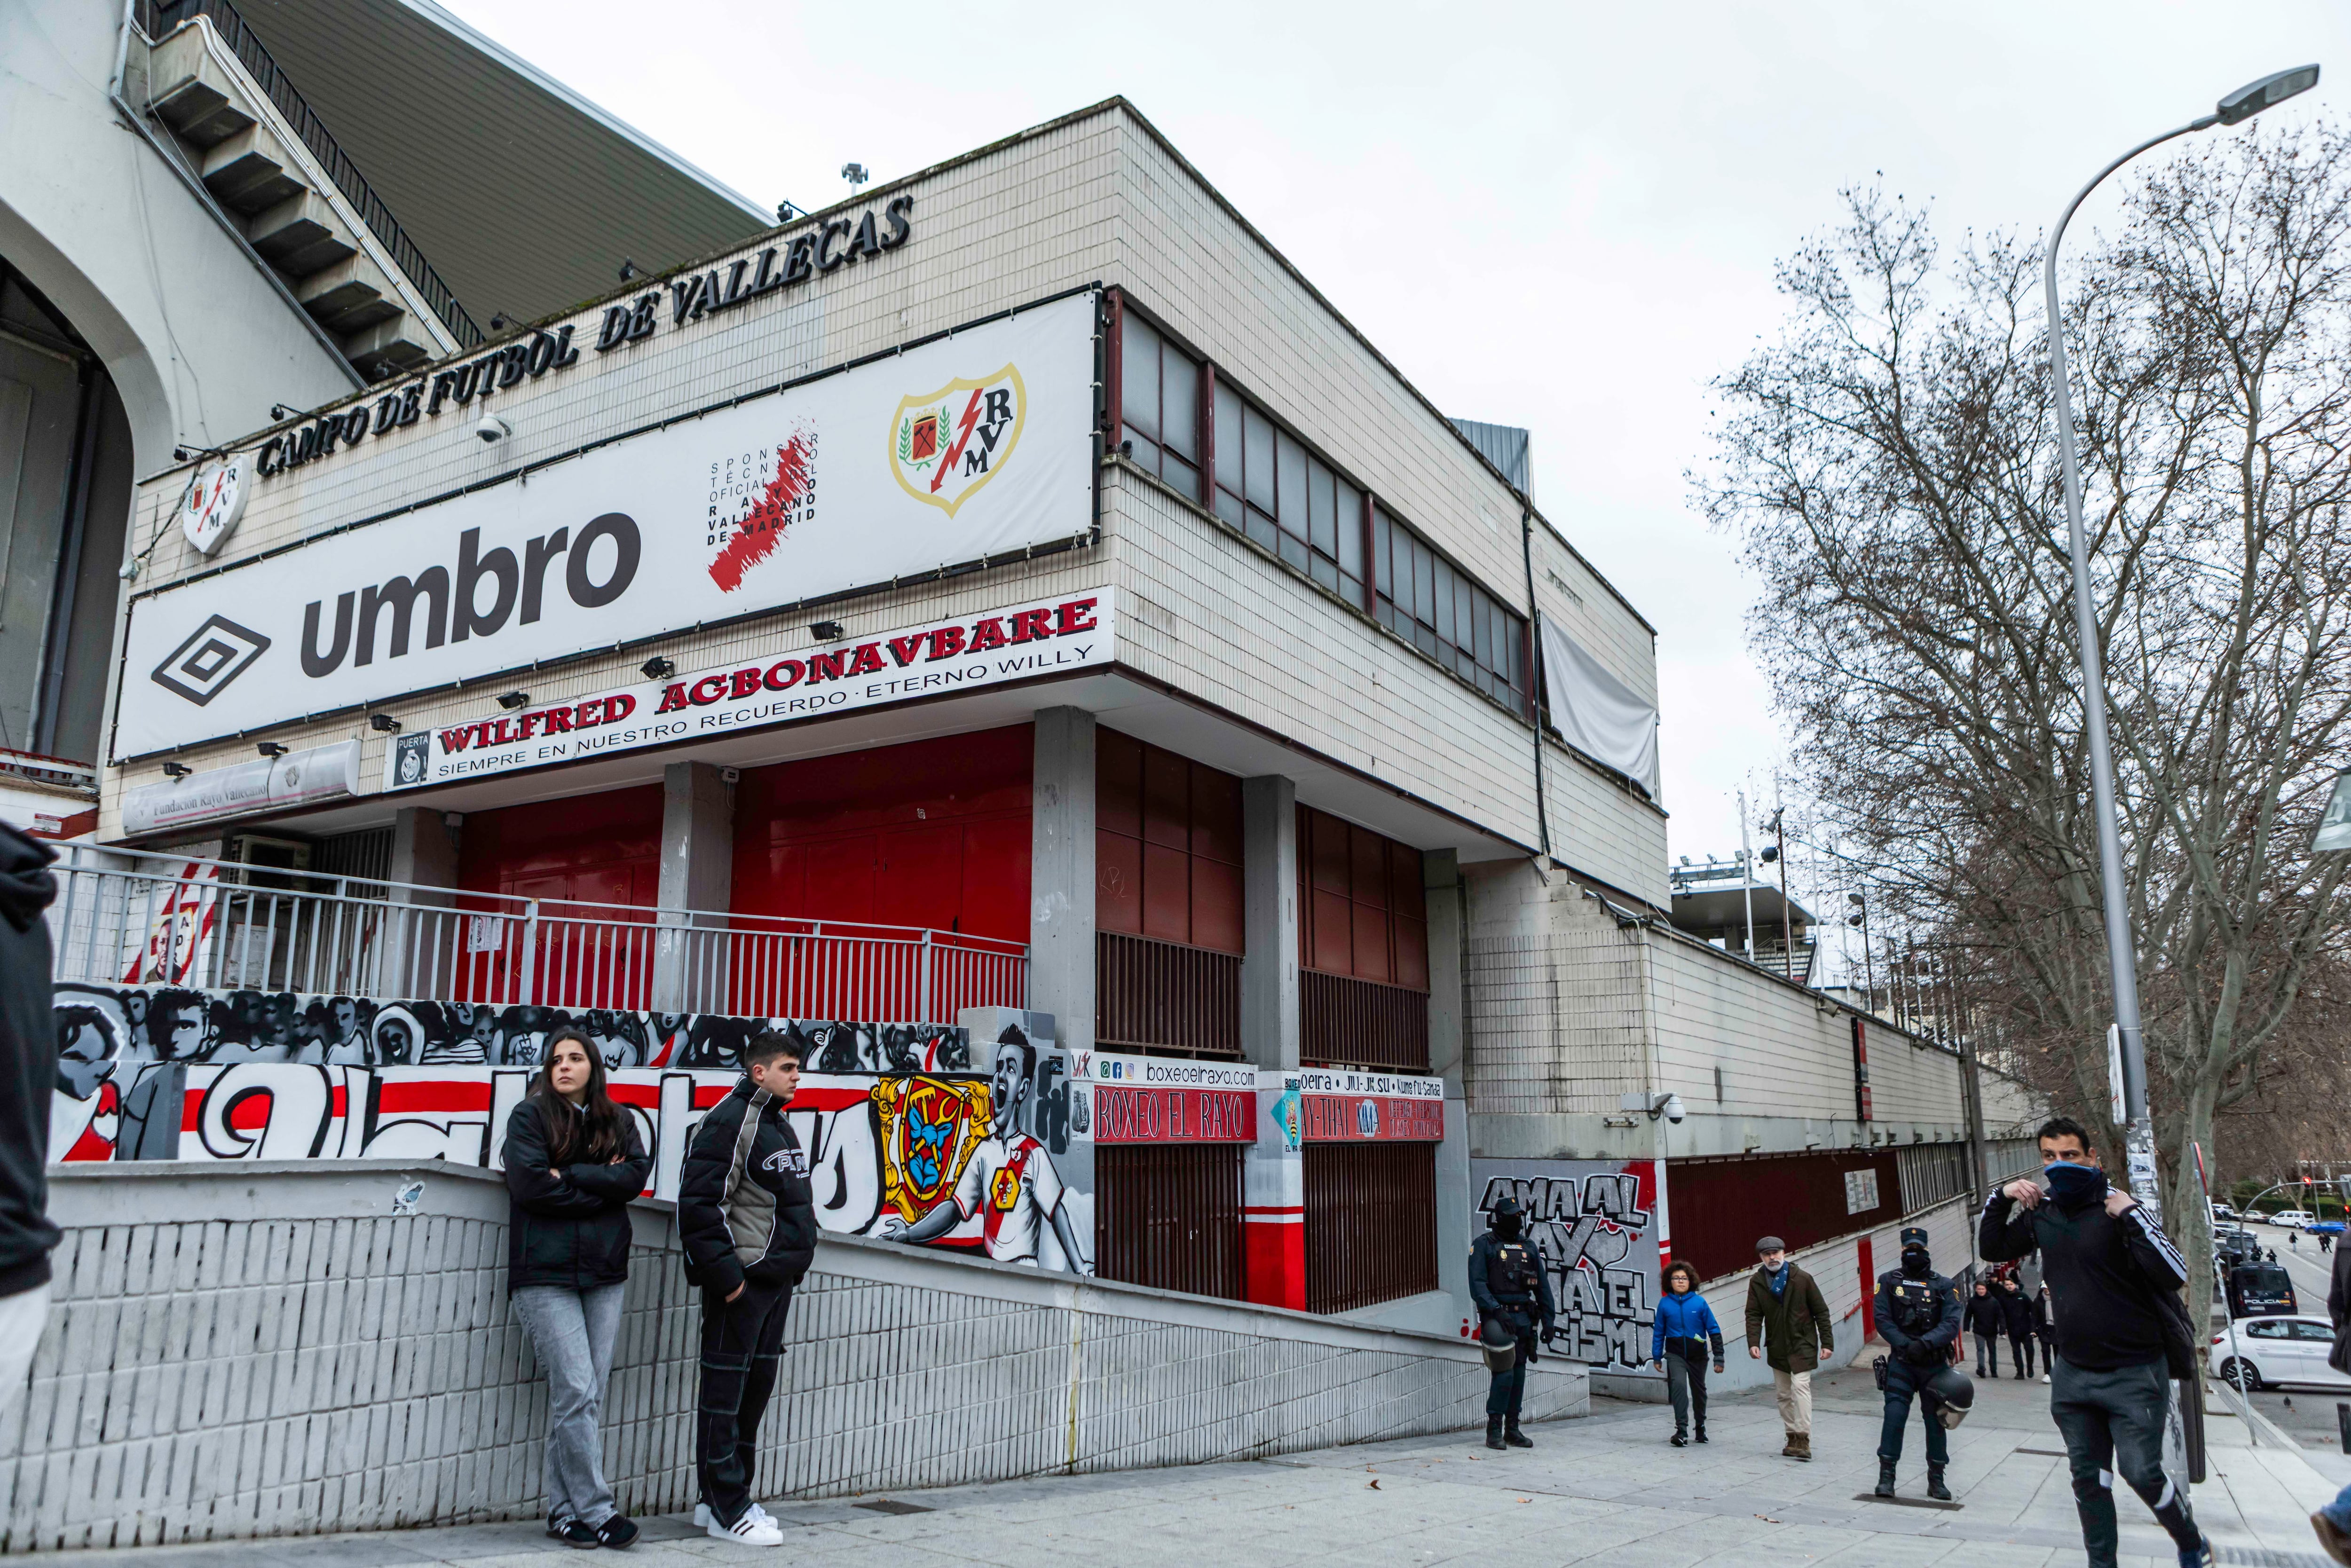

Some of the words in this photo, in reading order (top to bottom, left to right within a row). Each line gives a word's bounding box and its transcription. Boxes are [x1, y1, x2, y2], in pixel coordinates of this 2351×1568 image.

[257, 404, 370, 477] CAMPO
[371, 382, 426, 435] DE
[426, 324, 579, 416] FUTBOL
[594, 291, 660, 352] DE
[671, 195, 914, 325] VALLECAS
[710, 449, 817, 488] TÉCNICO
[711, 433, 818, 474] SPONSOR
[709, 478, 816, 517] RAYO
[710, 478, 768, 502] OFICIAL
[789, 463, 817, 481] DEL
[707, 531, 727, 546] DE
[743, 508, 815, 536] MADRID
[708, 493, 816, 531] VALLECANO
[300, 512, 642, 678] umbro
[437, 693, 637, 756] WILFRED
[654, 597, 1098, 716] AGBONAVBARE
[438, 751, 527, 777] SIEMPRE
[538, 745, 566, 759] EN
[578, 721, 687, 751] NUESTRO
[701, 691, 847, 729] RECUERDO
[866, 664, 988, 697] ETERNO
[997, 644, 1094, 674] WILLY
[398, 735, 428, 750] PUERTA
[1147, 1062, 1254, 1086] boxeoelrayo.com
[1285, 1078, 1301, 1088] BOXEO
[1301, 1074, 1332, 1091] oeira
[1096, 1089, 1161, 1138] BOXEO
[1168, 1092, 1193, 1137] EL
[1200, 1093, 1245, 1138] RAYO
[1301, 1097, 1349, 1137] AY-THAI
[1356, 1103, 1381, 1135] MMA
[1580, 1174, 1650, 1230] AL
[1599, 1269, 1658, 1324] EL
